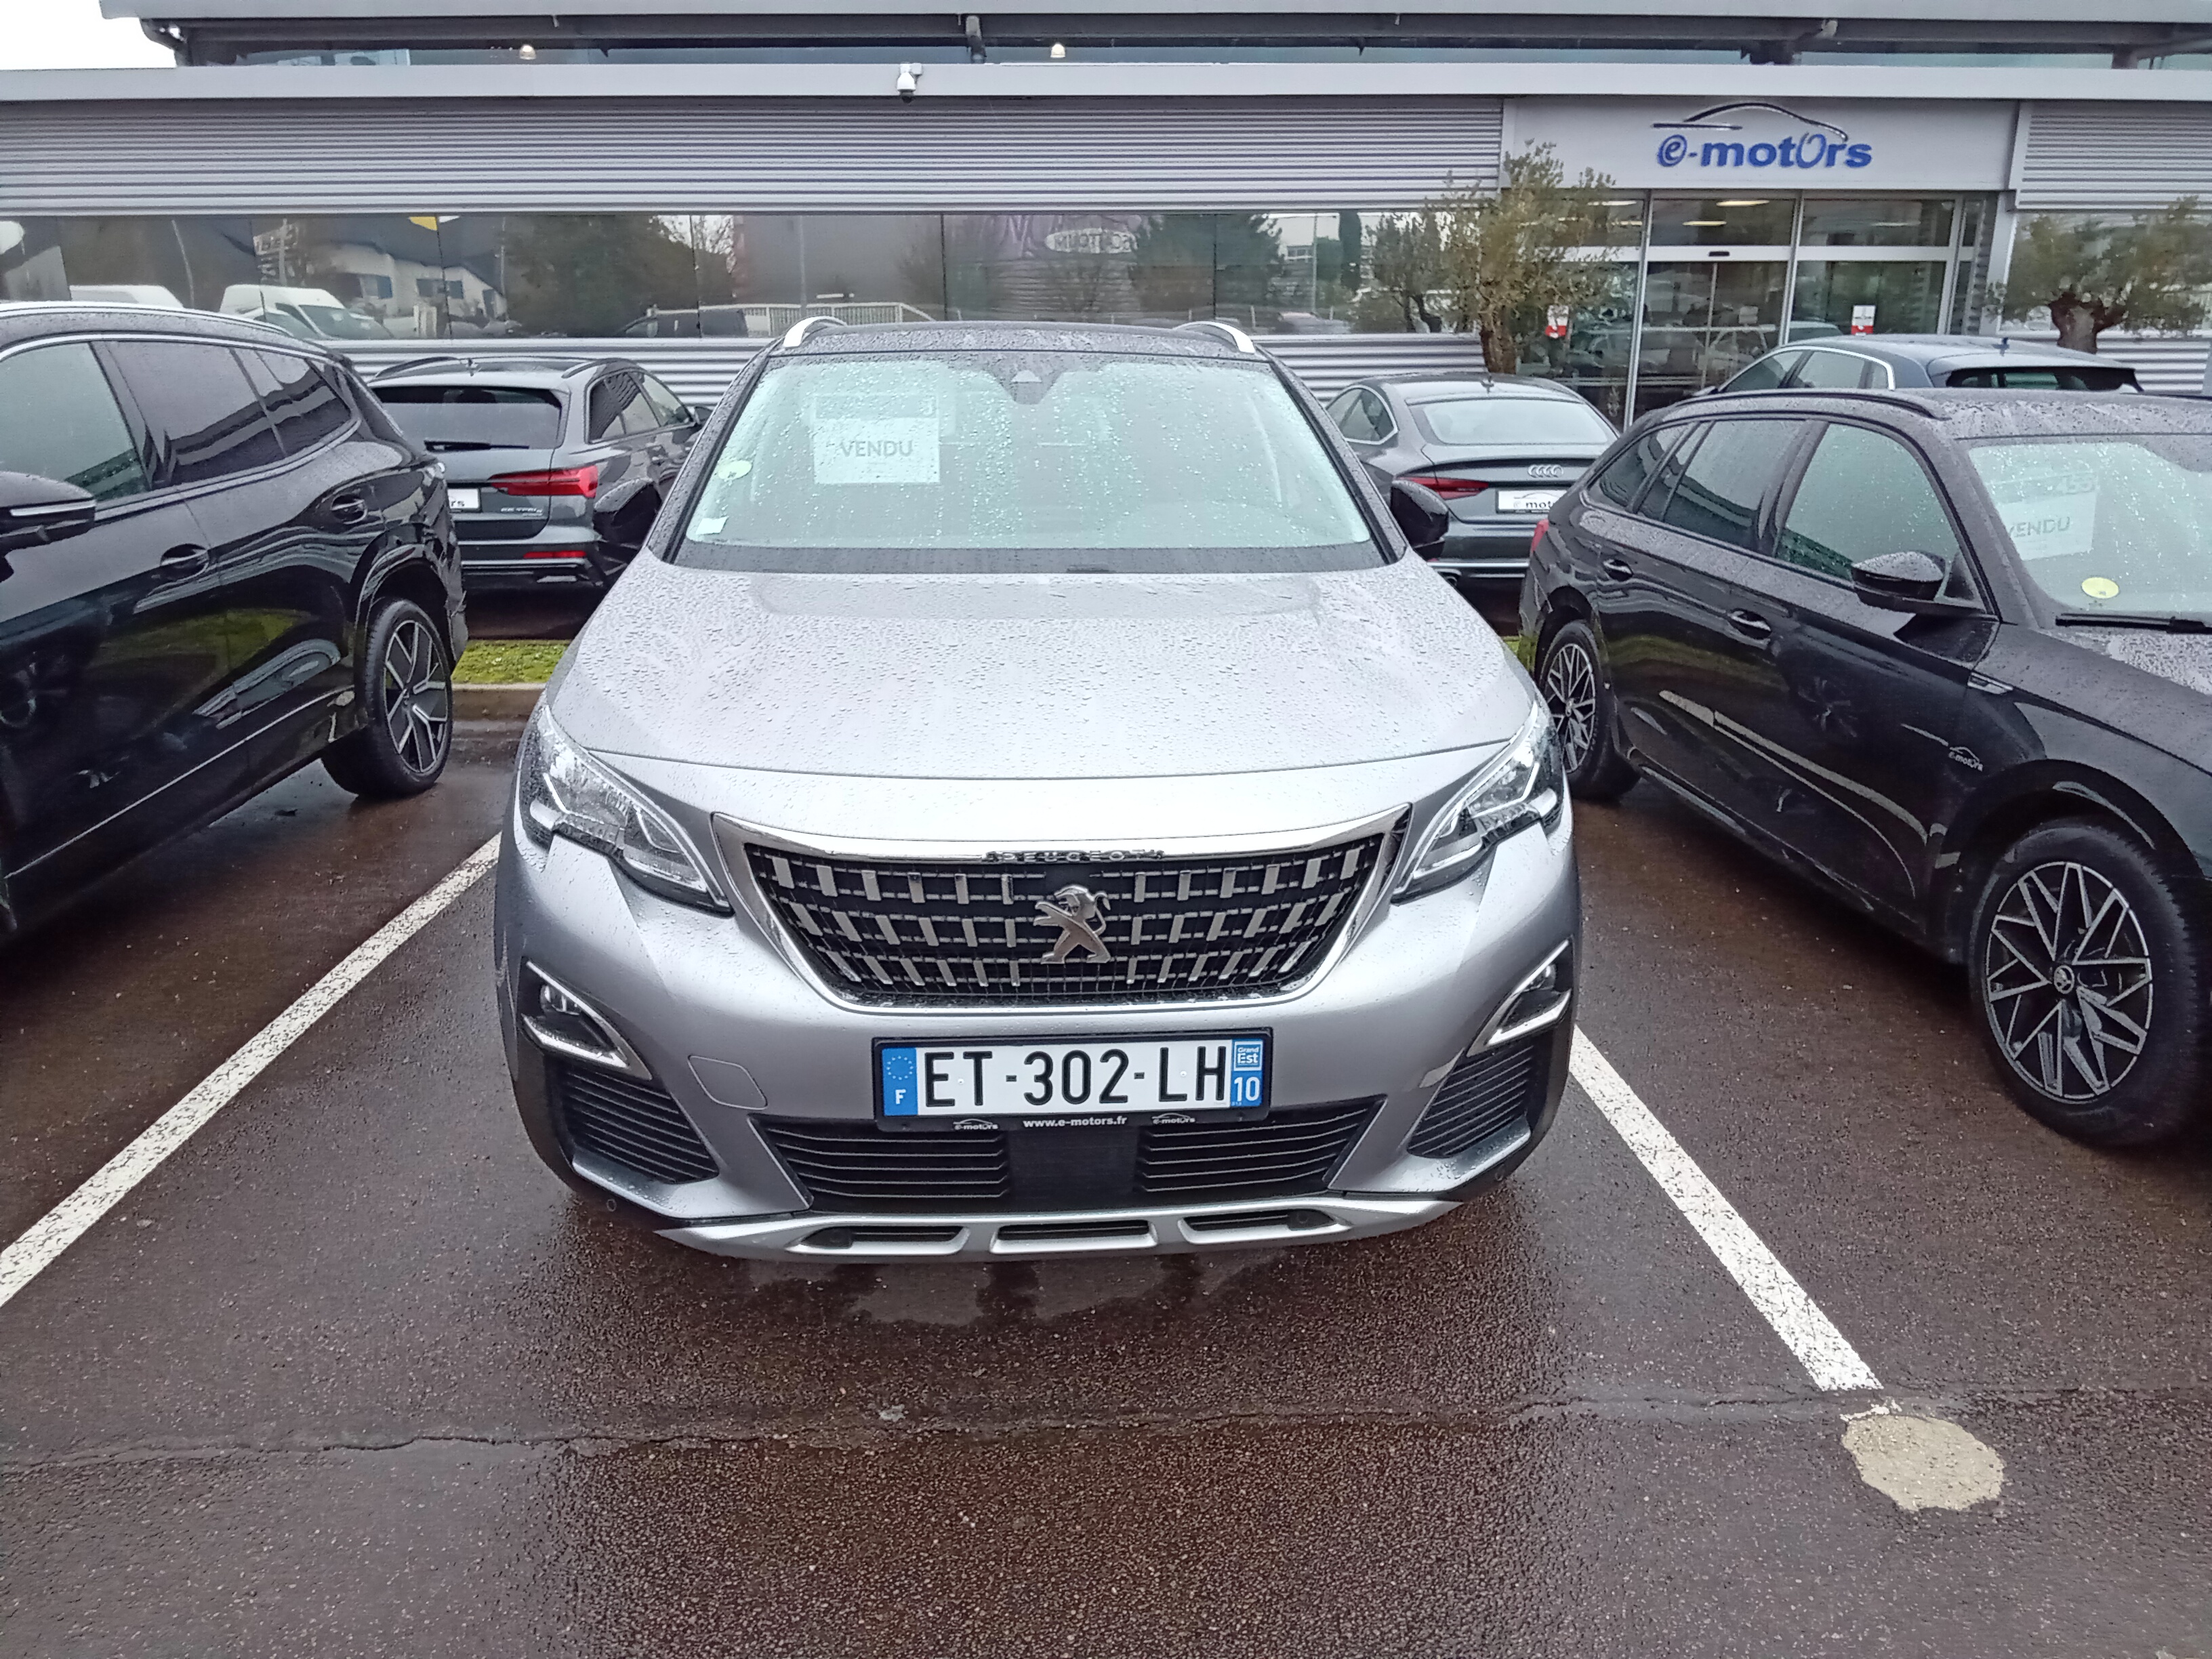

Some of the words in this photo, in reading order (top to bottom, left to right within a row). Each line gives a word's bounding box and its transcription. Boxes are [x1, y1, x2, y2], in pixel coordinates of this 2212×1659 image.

[839, 440, 914, 457] VENDU
[1237, 1052, 1259, 1064] Est
[924, 1045, 1227, 1108] ET-302-LH
[895, 1089, 907, 1105] F
[1233, 1076, 1261, 1103] 10
[1022, 1115, 1128, 1128] www.e-motors.fr
